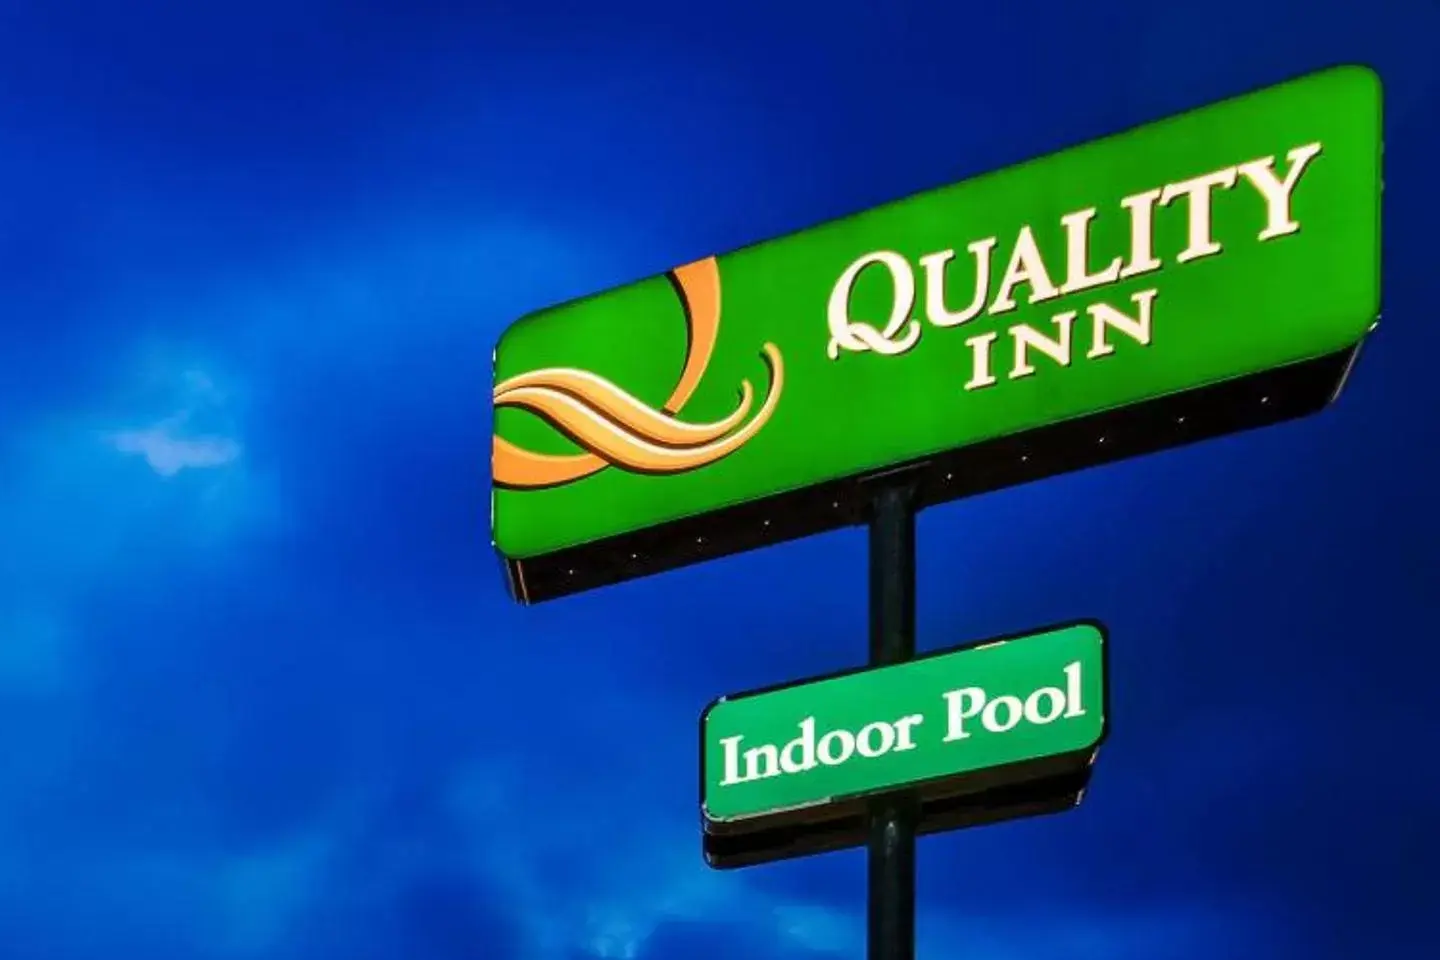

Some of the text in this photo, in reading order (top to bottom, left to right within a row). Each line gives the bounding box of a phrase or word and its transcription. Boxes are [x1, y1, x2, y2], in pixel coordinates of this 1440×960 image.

[827, 142, 1321, 360] QUALITY
[964, 288, 1158, 390] INN
[719, 660, 1087, 787] Indoor Pool
